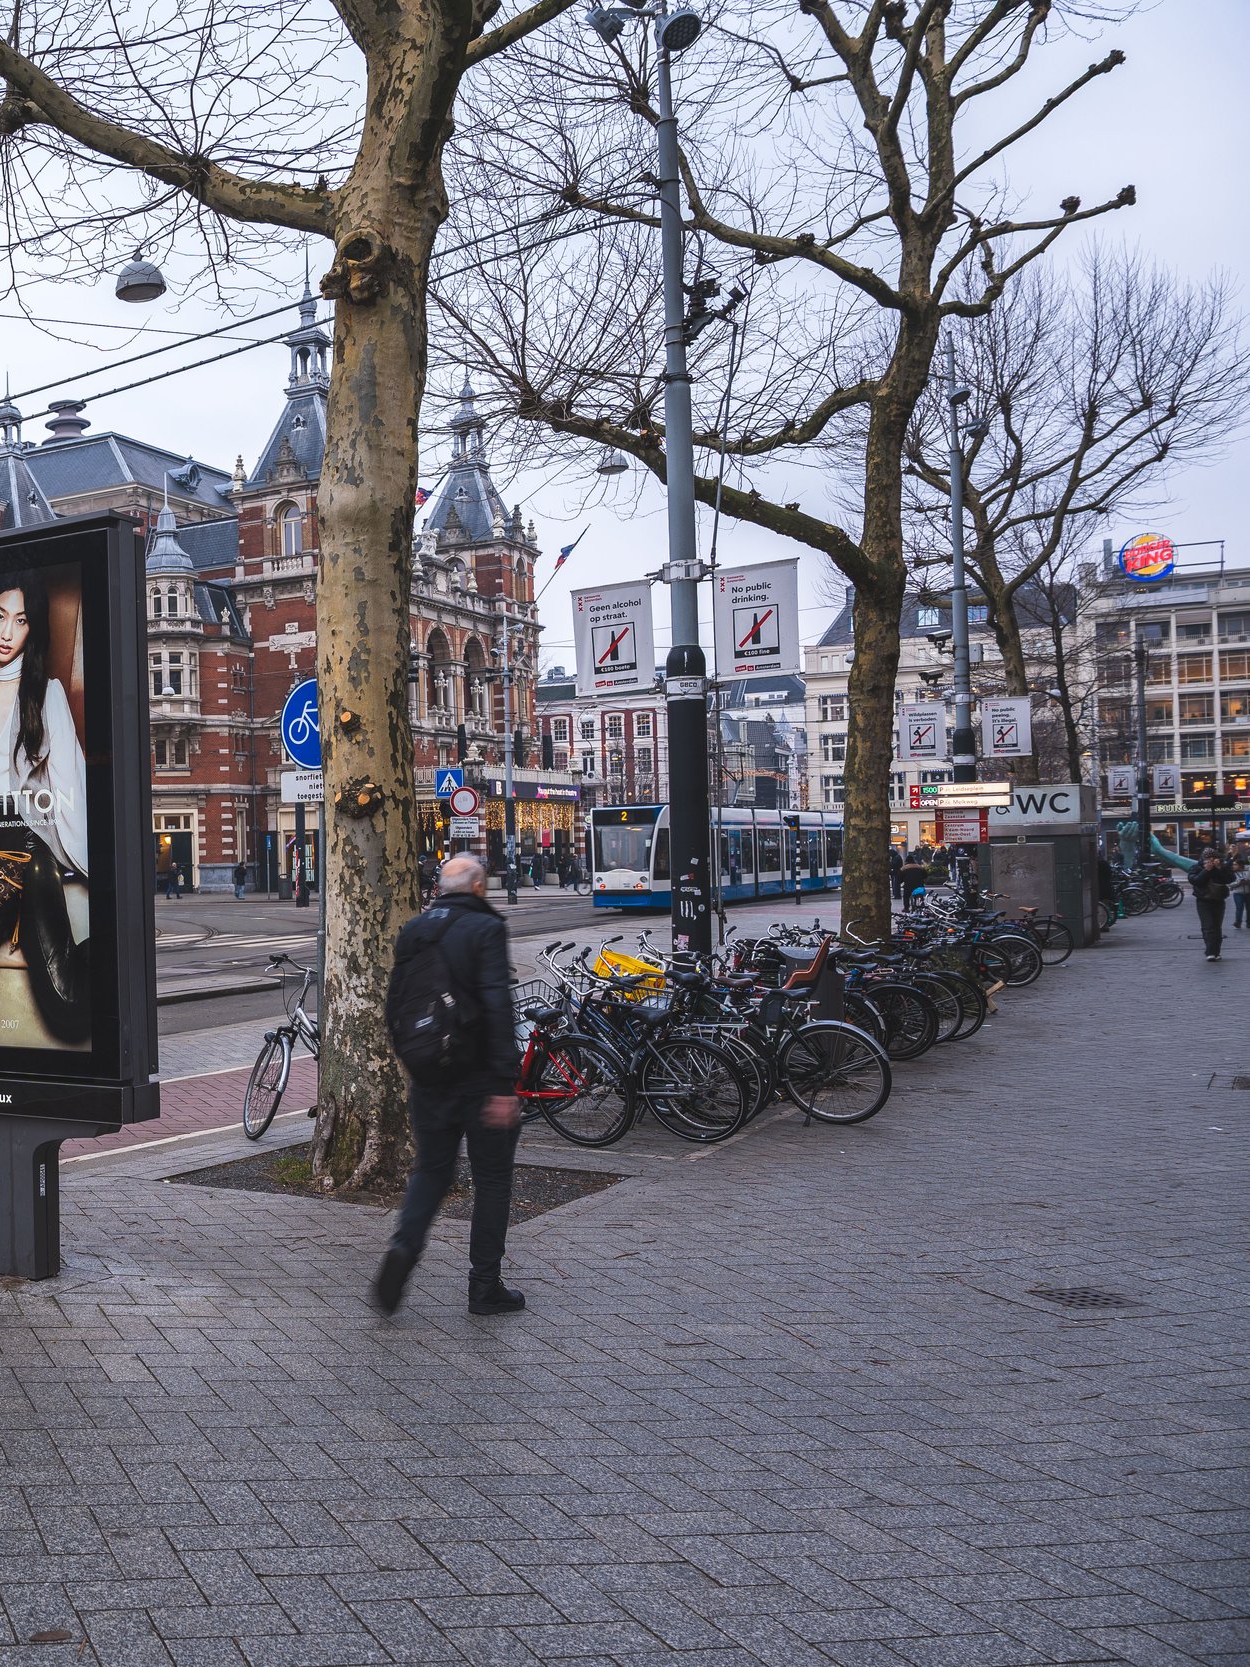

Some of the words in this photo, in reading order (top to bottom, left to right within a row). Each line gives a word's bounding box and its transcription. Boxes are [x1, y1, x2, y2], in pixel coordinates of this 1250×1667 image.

[1127, 547, 1173, 573] KING
[746, 582, 772, 593] public
[732, 594, 769, 604] drinking.
[590, 604, 610, 612] Geen
[612, 598, 642, 609] alcohol
[602, 612, 628, 620] straat.
[1016, 792, 1070, 814] WC
[621, 811, 628, 821] 2
[1, 1019, 19, 1029] 2007
